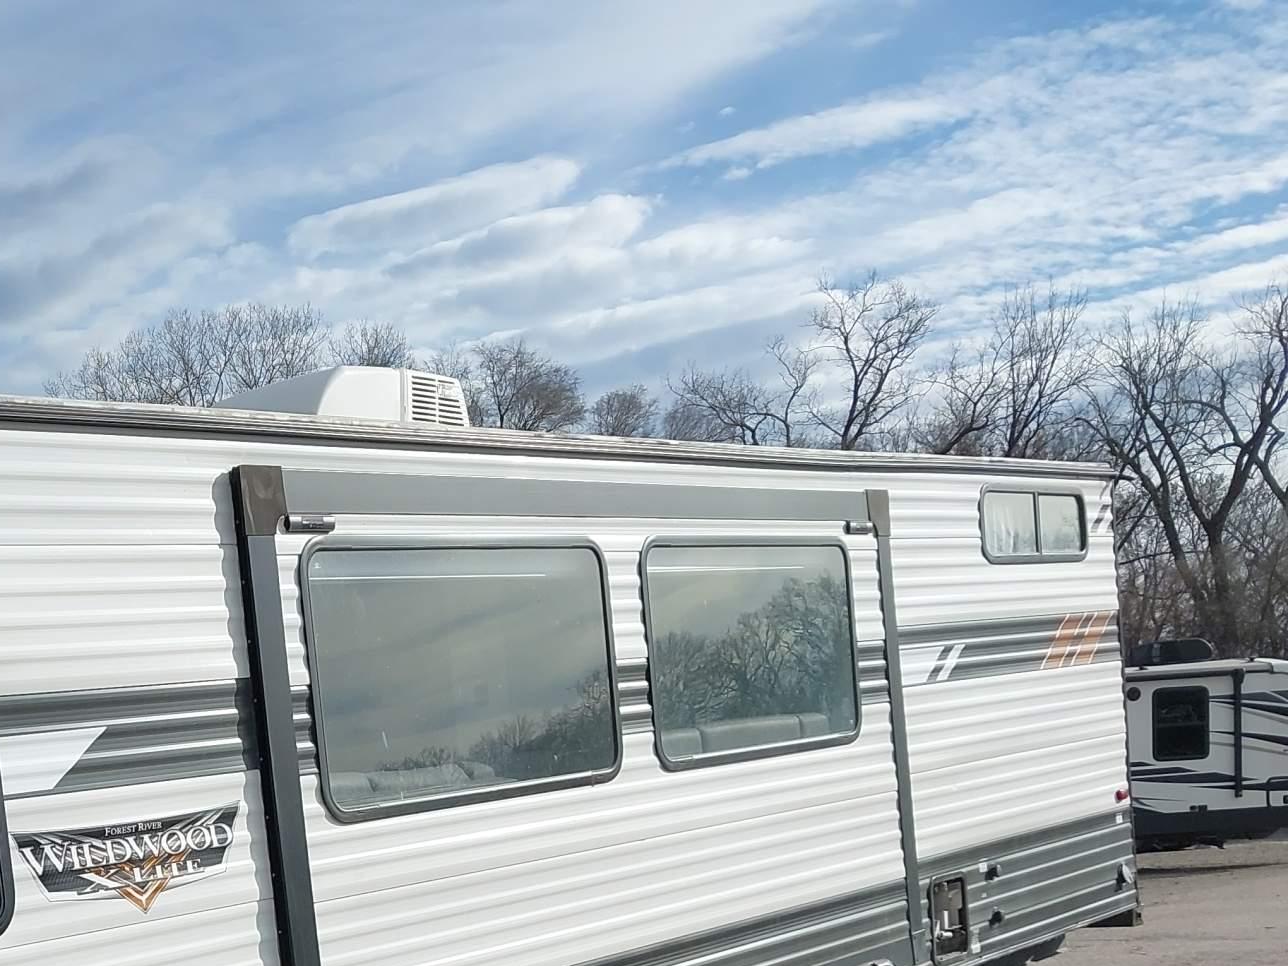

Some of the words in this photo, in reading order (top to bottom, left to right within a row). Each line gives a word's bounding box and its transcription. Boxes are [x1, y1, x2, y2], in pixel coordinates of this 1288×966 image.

[104, 822, 139, 837] FOREST
[138, 821, 163, 834] RIVER
[19, 822, 233, 876] WILDWOOD
[77, 868, 129, 896] X
[132, 858, 206, 883] LITE
